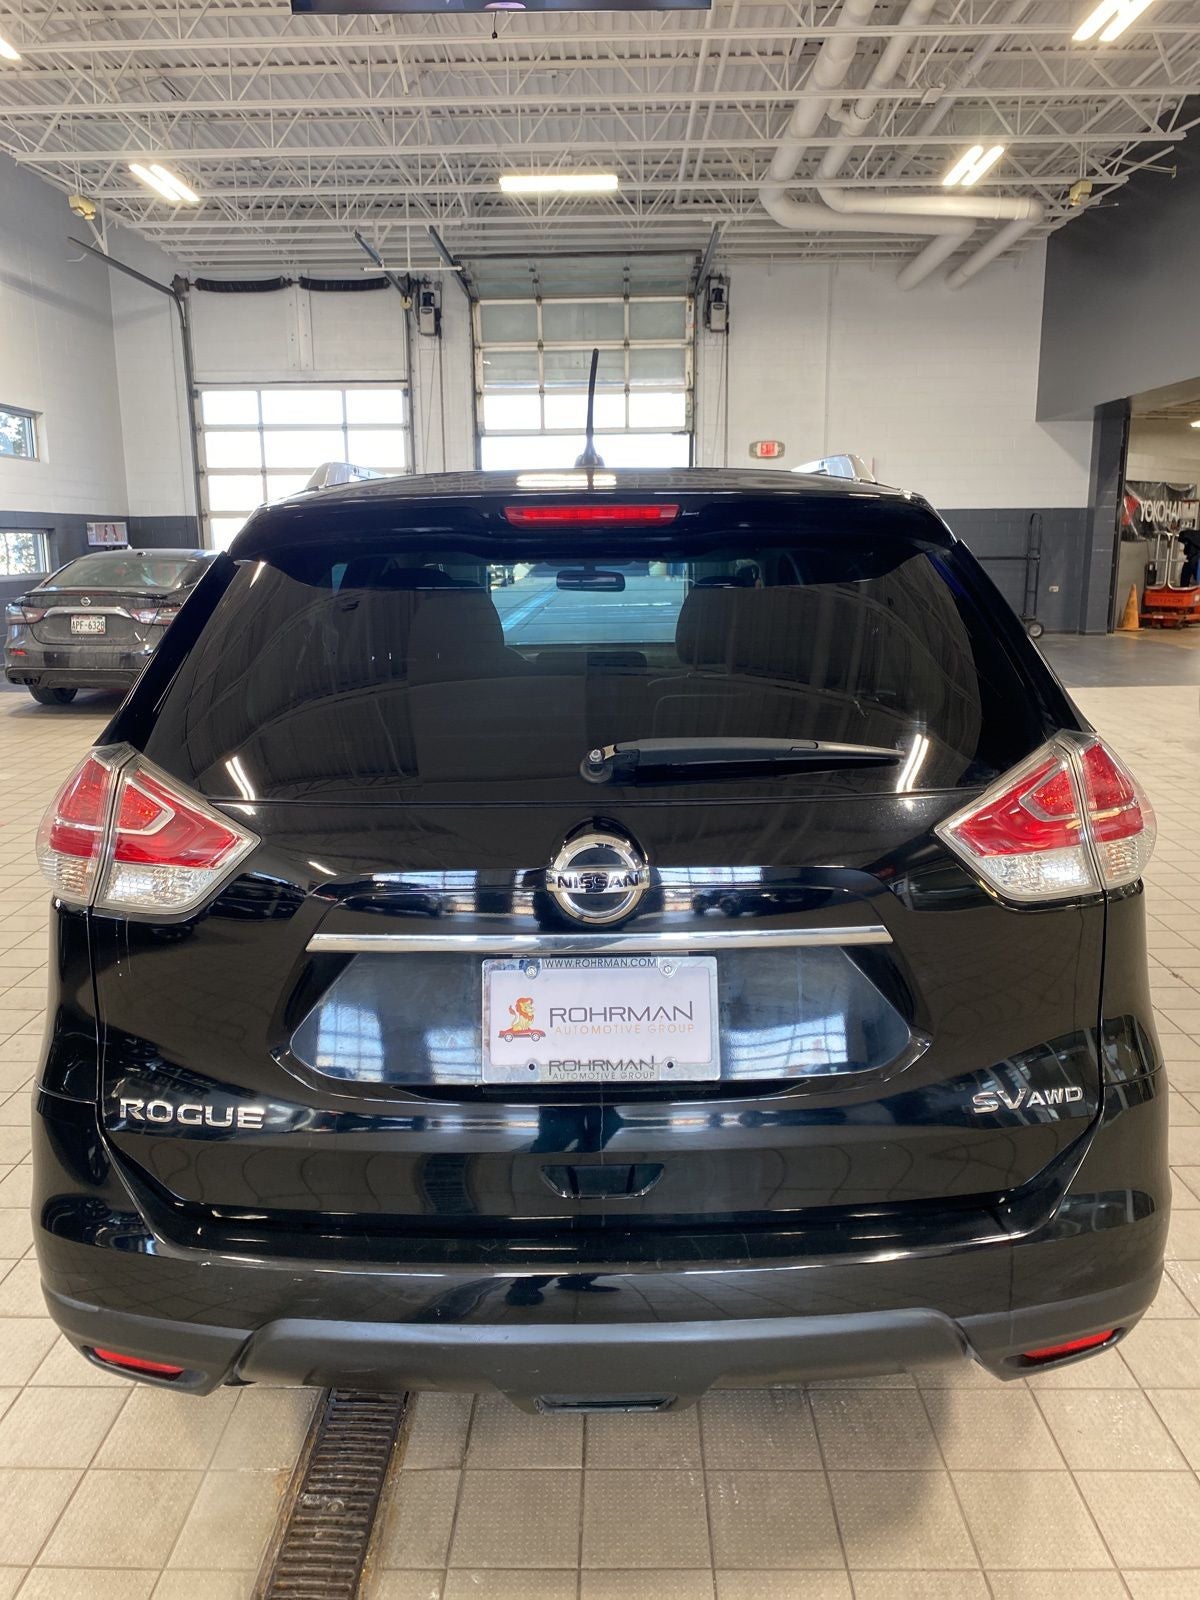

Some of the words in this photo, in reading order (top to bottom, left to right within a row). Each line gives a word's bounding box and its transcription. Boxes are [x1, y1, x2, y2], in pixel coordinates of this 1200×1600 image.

[557, 872, 639, 890] NISSAN
[545, 957, 657, 968] WWW.ROHRMAN.COM
[549, 1000, 693, 1028] ROHRMAN
[555, 1024, 641, 1035] AUTOMOTIVE
[647, 1024, 695, 1034] GROUP
[548, 1055, 654, 1075] ROHRMAN
[552, 1071, 616, 1080] AUTOMOTIVE
[621, 1071, 655, 1080] GROUP
[1026, 1086, 1083, 1108] AWD
[119, 1098, 265, 1129] ROGUE
